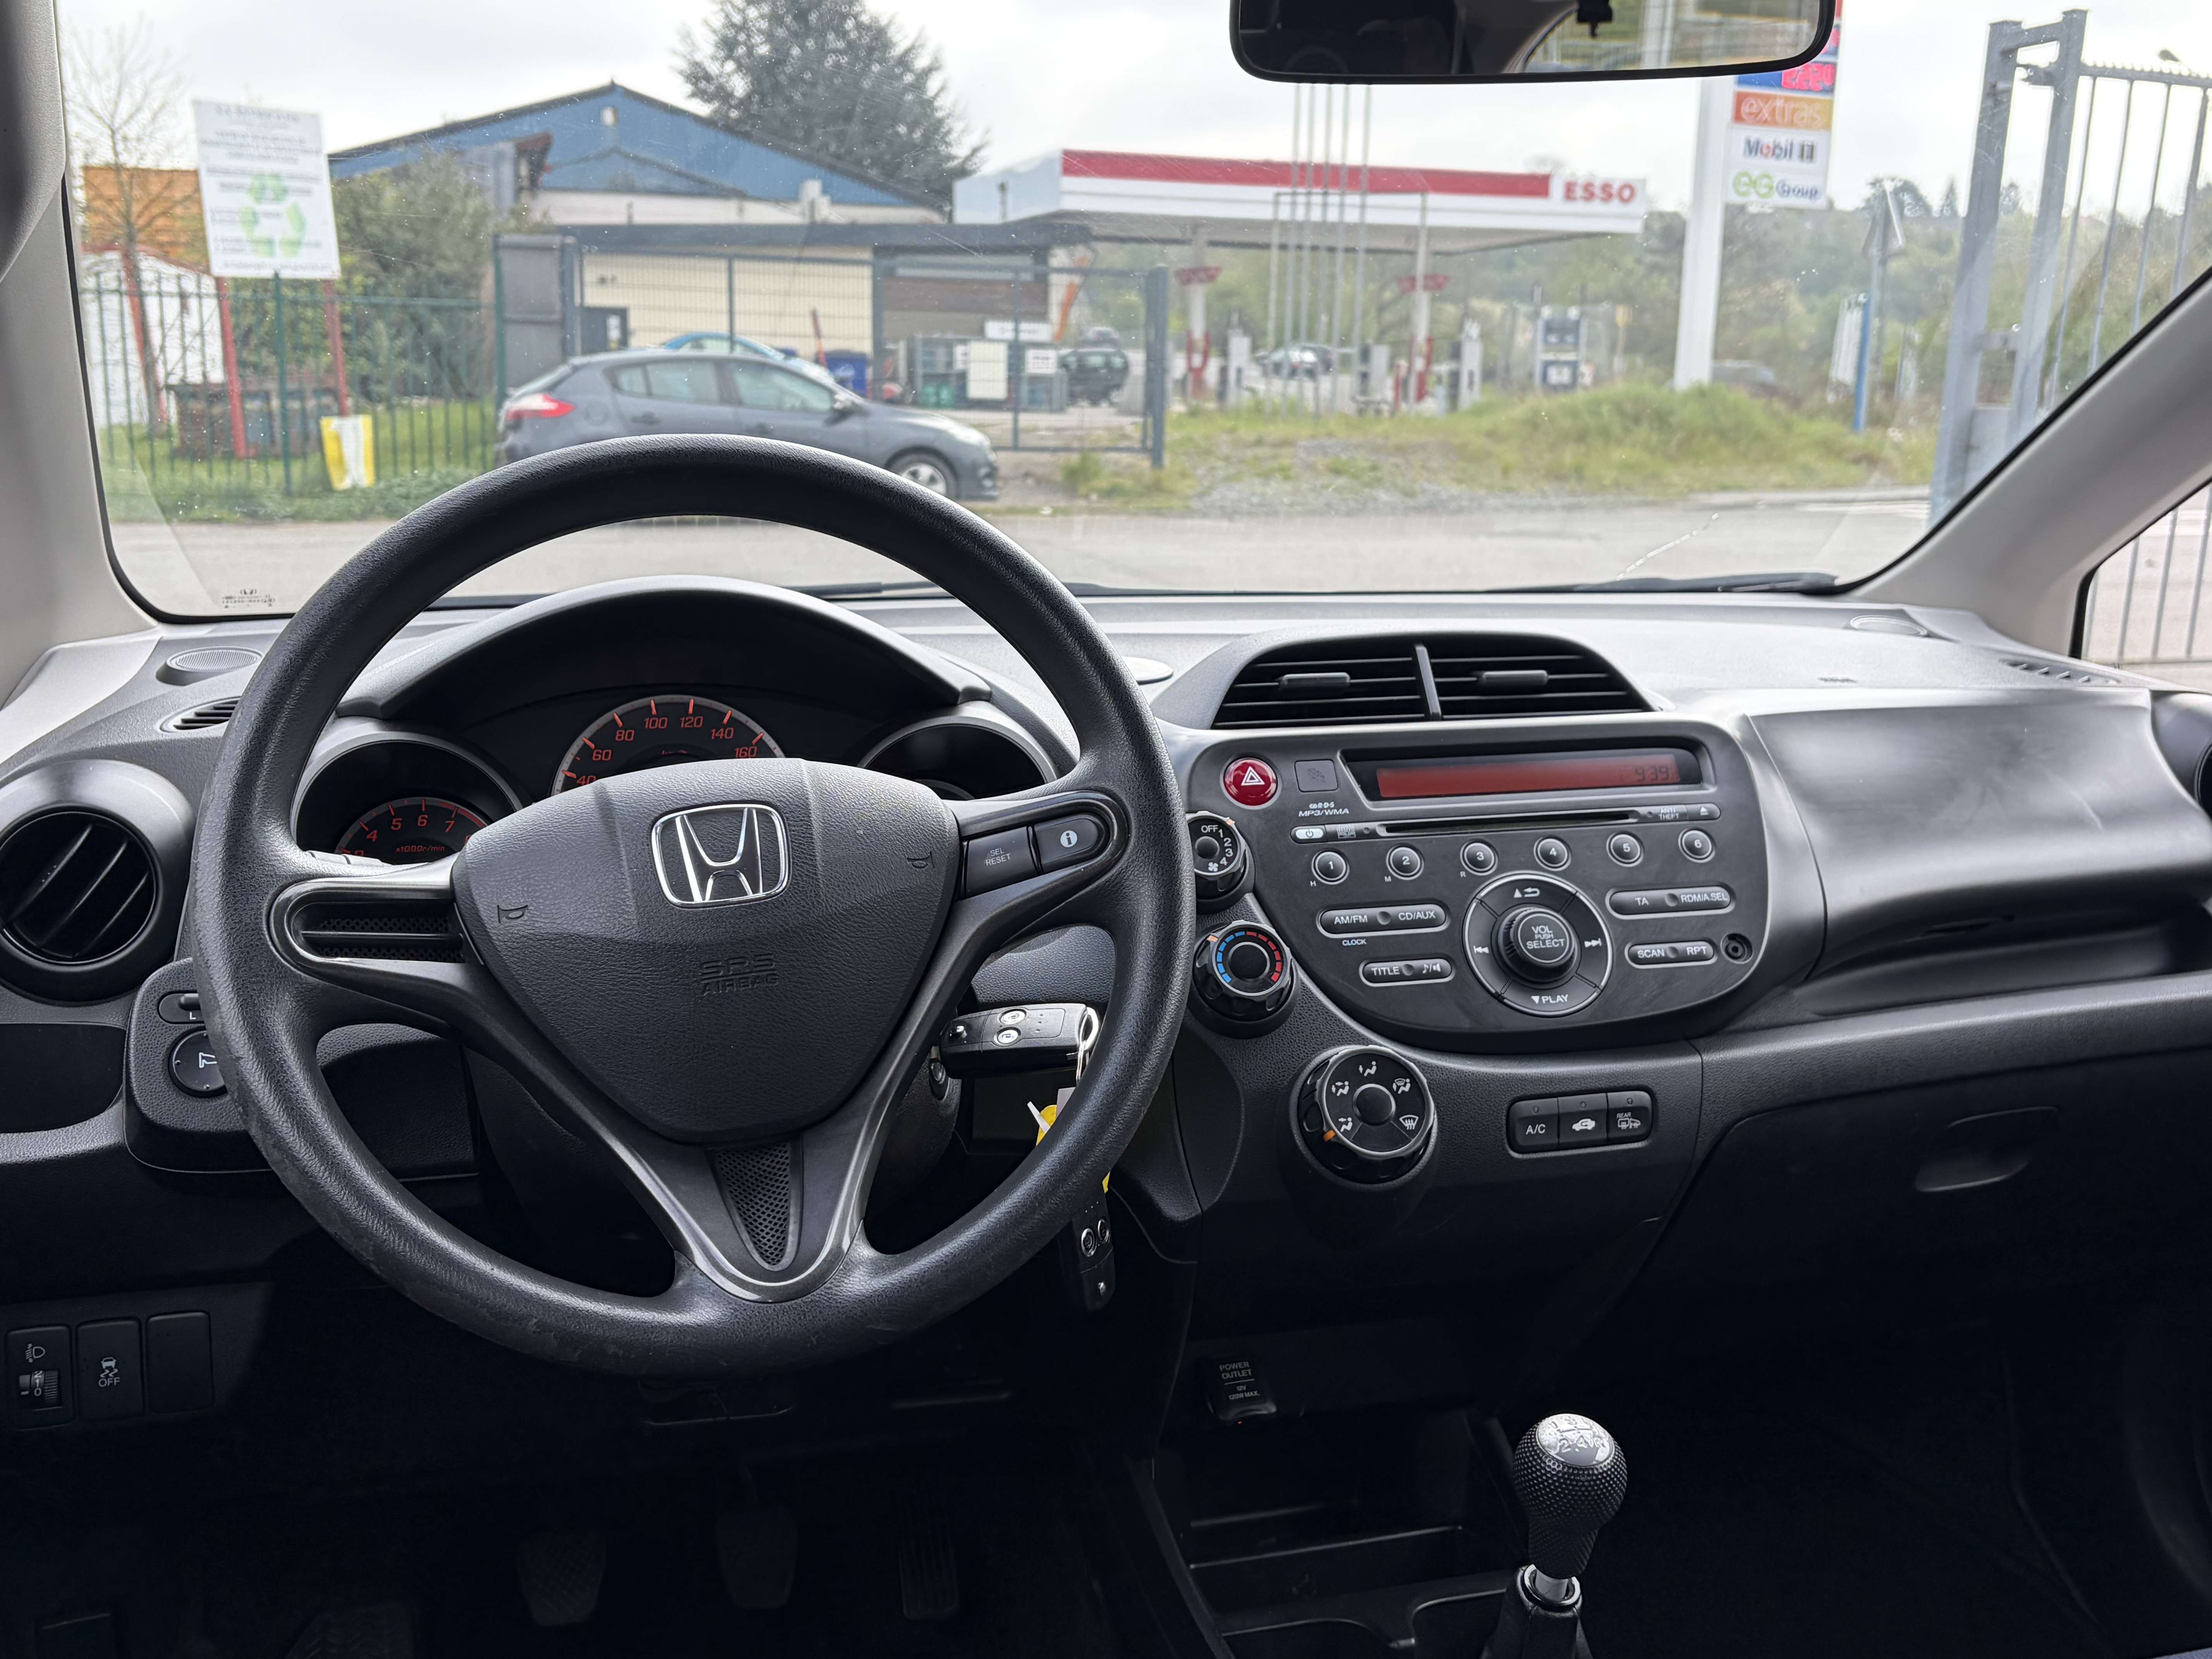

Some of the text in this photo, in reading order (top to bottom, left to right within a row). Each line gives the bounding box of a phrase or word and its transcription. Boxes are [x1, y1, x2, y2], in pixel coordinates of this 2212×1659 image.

[1742, 97, 1821, 128] extras
[1744, 136, 1794, 161] Mobil
[1564, 181, 1636, 204] ESSO
[1775, 178, 1820, 201] Group
[644, 716, 703, 729] 100 120
[615, 727, 734, 742] 80 140
[592, 746, 757, 761] 60 160
[1298, 808, 1349, 817] MP3/WMA
[391, 818, 455, 833] 5 7
[418, 815, 428, 826] 6
[366, 830, 378, 842] 4
[1201, 825, 1233, 866] OFF 1 2 3 4
[990, 848, 1004, 857] SEL
[1329, 839, 1702, 869] 1 2 3 4 5 6
[986, 853, 1011, 866] RESET
[1635, 892, 1728, 906] TA RDM/A.SEL
[1334, 911, 1436, 924] AM/FM CD/AUX
[1531, 925, 1553, 934] VOL
[1527, 939, 1565, 949] SELECT
[1637, 946, 1707, 958] SCAN RPT
[699, 953, 775, 976] SRS
[1371, 966, 1400, 976] TITLE
[701, 973, 779, 996] AIRBAG
[1541, 994, 1568, 1004] PLAY
[189, 1012, 196, 1020] L
[1526, 1124, 1546, 1135] A/C
[1219, 1361, 1250, 1371] POWER
[1221, 1369, 1252, 1379] OUTLET
[35, 1379, 40, 1387] 1
[98, 1377, 120, 1388] OFF
[34, 1388, 42, 1397] 0
